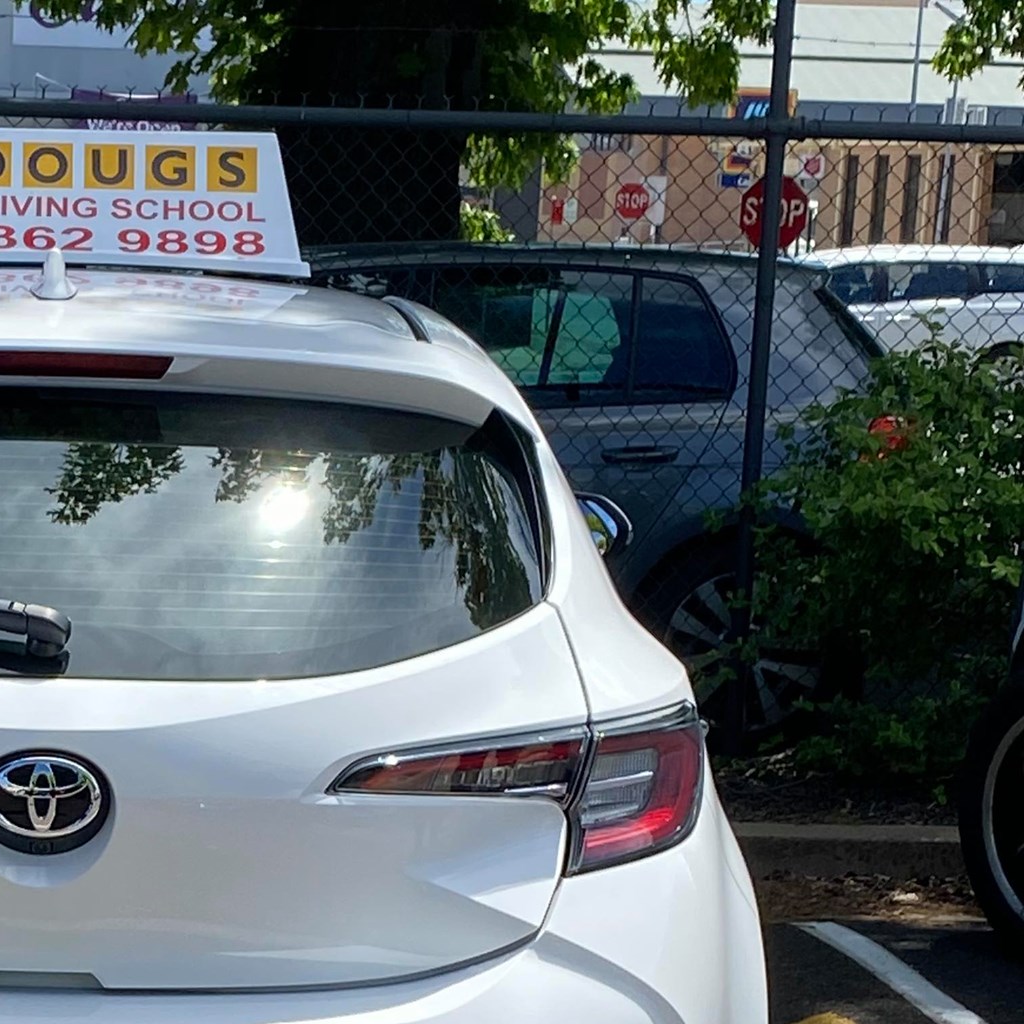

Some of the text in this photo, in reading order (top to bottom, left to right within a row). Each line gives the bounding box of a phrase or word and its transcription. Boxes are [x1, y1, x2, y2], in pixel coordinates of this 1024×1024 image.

[111, 198, 266, 223] SCHOOL
[616, 193, 649, 208] STOP
[117, 229, 266, 256] 9898
